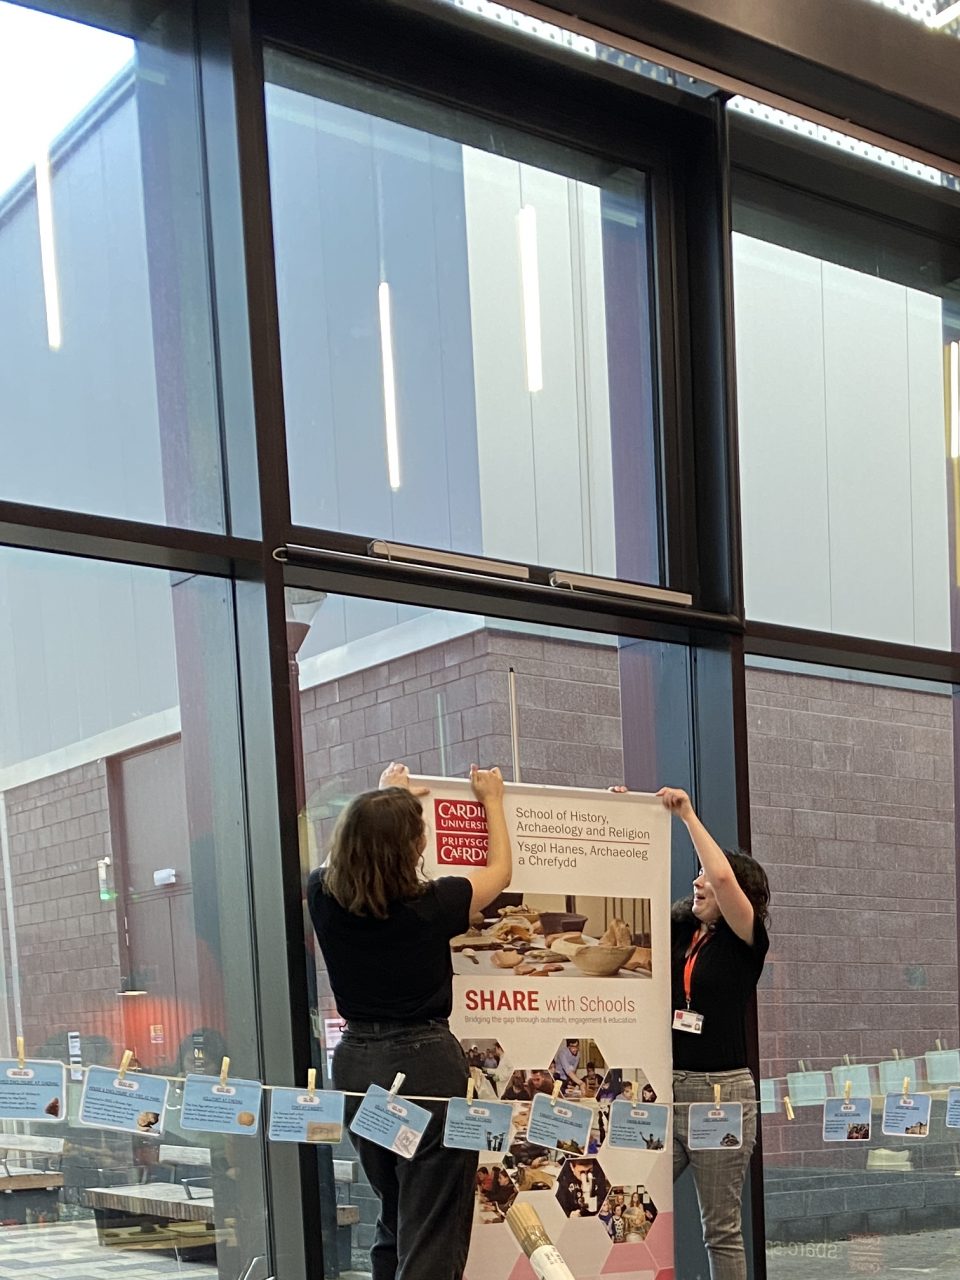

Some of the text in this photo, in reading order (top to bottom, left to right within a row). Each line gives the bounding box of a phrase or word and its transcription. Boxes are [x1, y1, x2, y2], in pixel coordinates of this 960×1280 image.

[516, 807, 609, 825] School of History,
[516, 821, 650, 840] Archaeology and Religion
[517, 841, 648, 861] Ysgol Hanes, Archaeoleg
[528, 855, 577, 869] Chrefydd
[465, 989, 635, 1012] SHARE with Schools
[464, 1016, 490, 1024] Bridging
[516, 1016, 539, 1024] through
